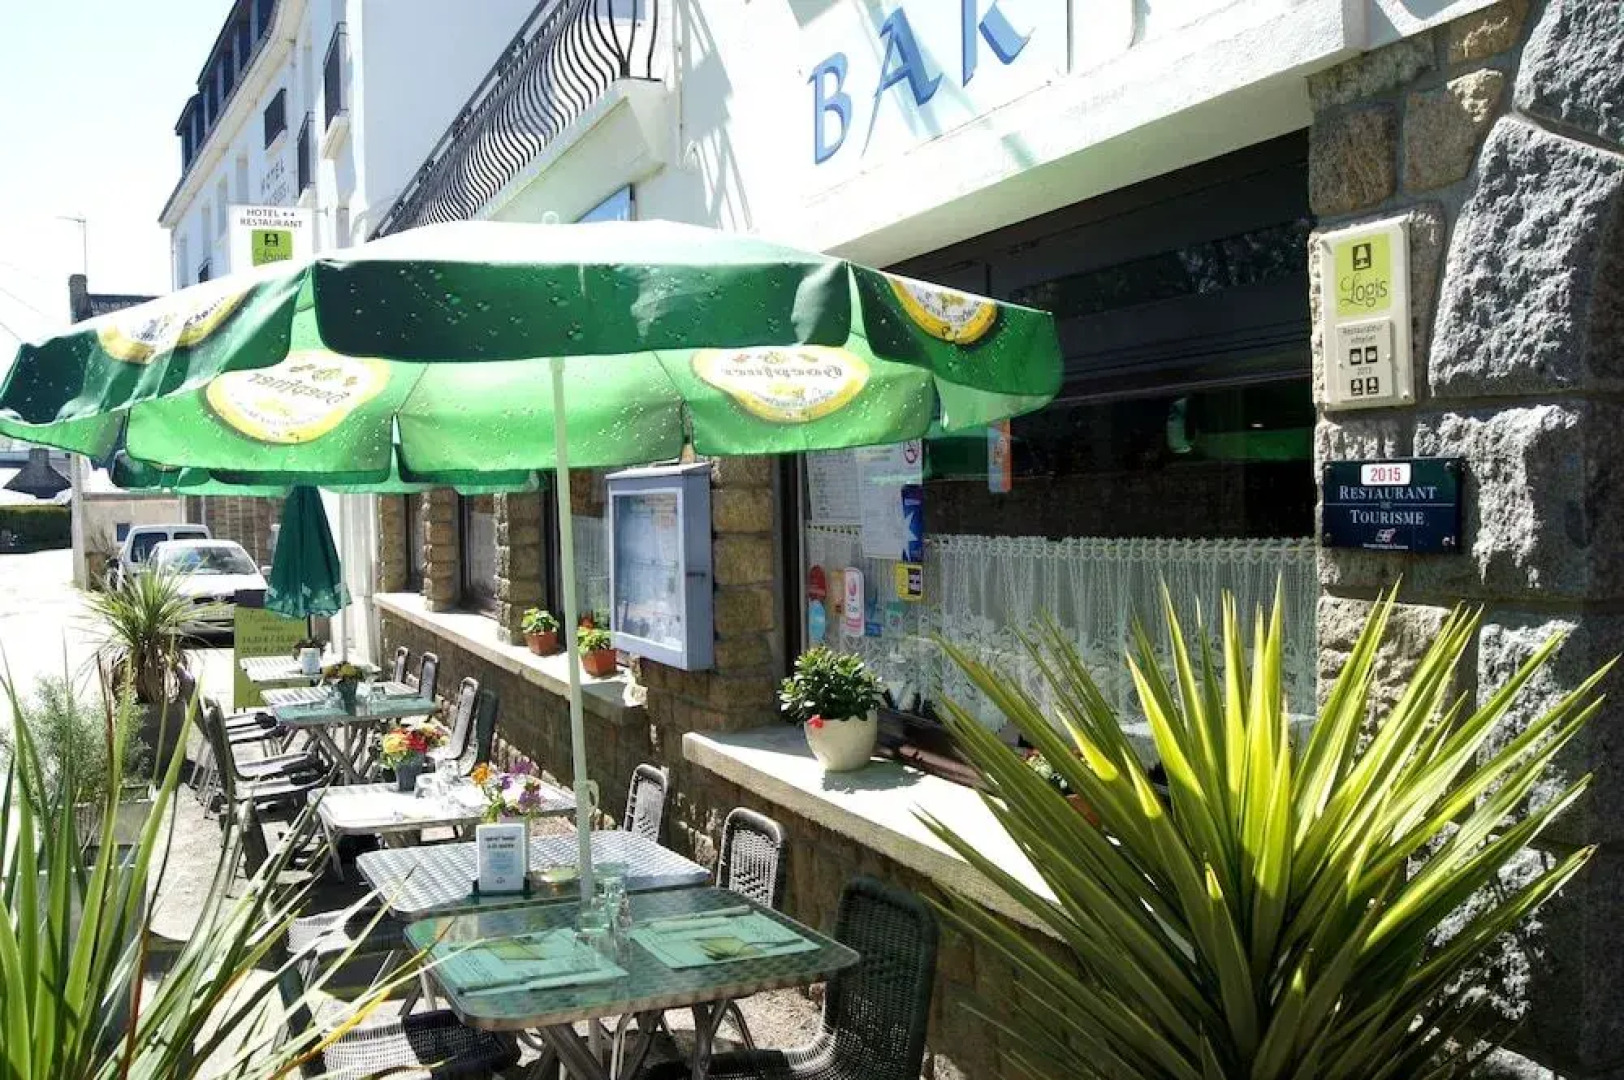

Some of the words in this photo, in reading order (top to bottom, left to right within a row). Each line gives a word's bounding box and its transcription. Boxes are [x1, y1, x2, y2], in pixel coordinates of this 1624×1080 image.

[246, 208, 279, 217] HOTEL
[240, 218, 302, 228] RESTAURANT
[1339, 272, 1388, 308] Logis
[1370, 467, 1401, 482] 2015
[1339, 485, 1437, 500] RESTAURANT
[1349, 509, 1425, 526] TOURISME
